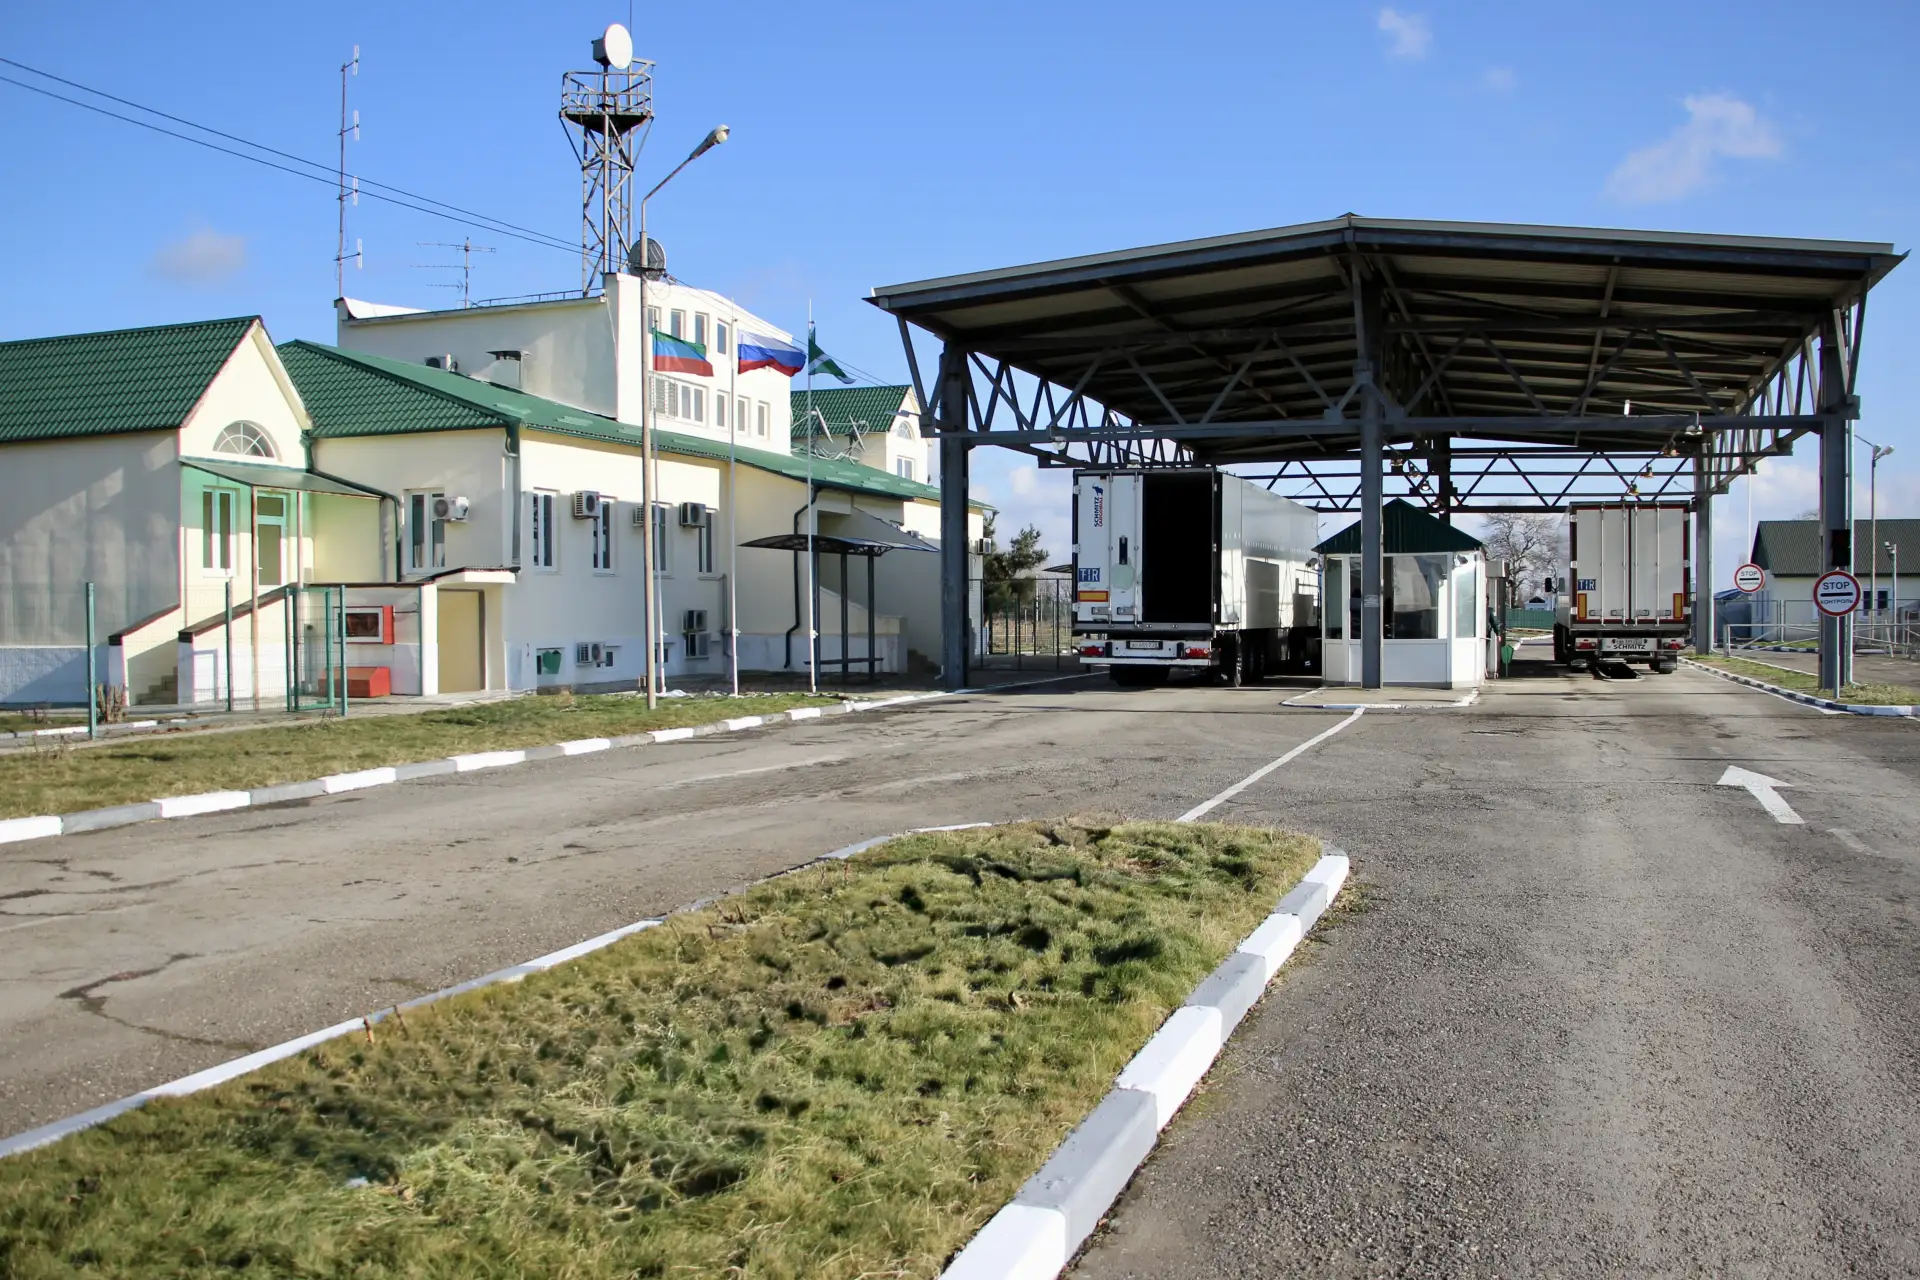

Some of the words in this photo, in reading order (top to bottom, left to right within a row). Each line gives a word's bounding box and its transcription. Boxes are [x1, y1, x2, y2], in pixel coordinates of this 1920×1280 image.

[1080, 569, 1098, 581] TIR
[1579, 580, 1595, 590] TIR
[1823, 581, 1850, 590] STOP
